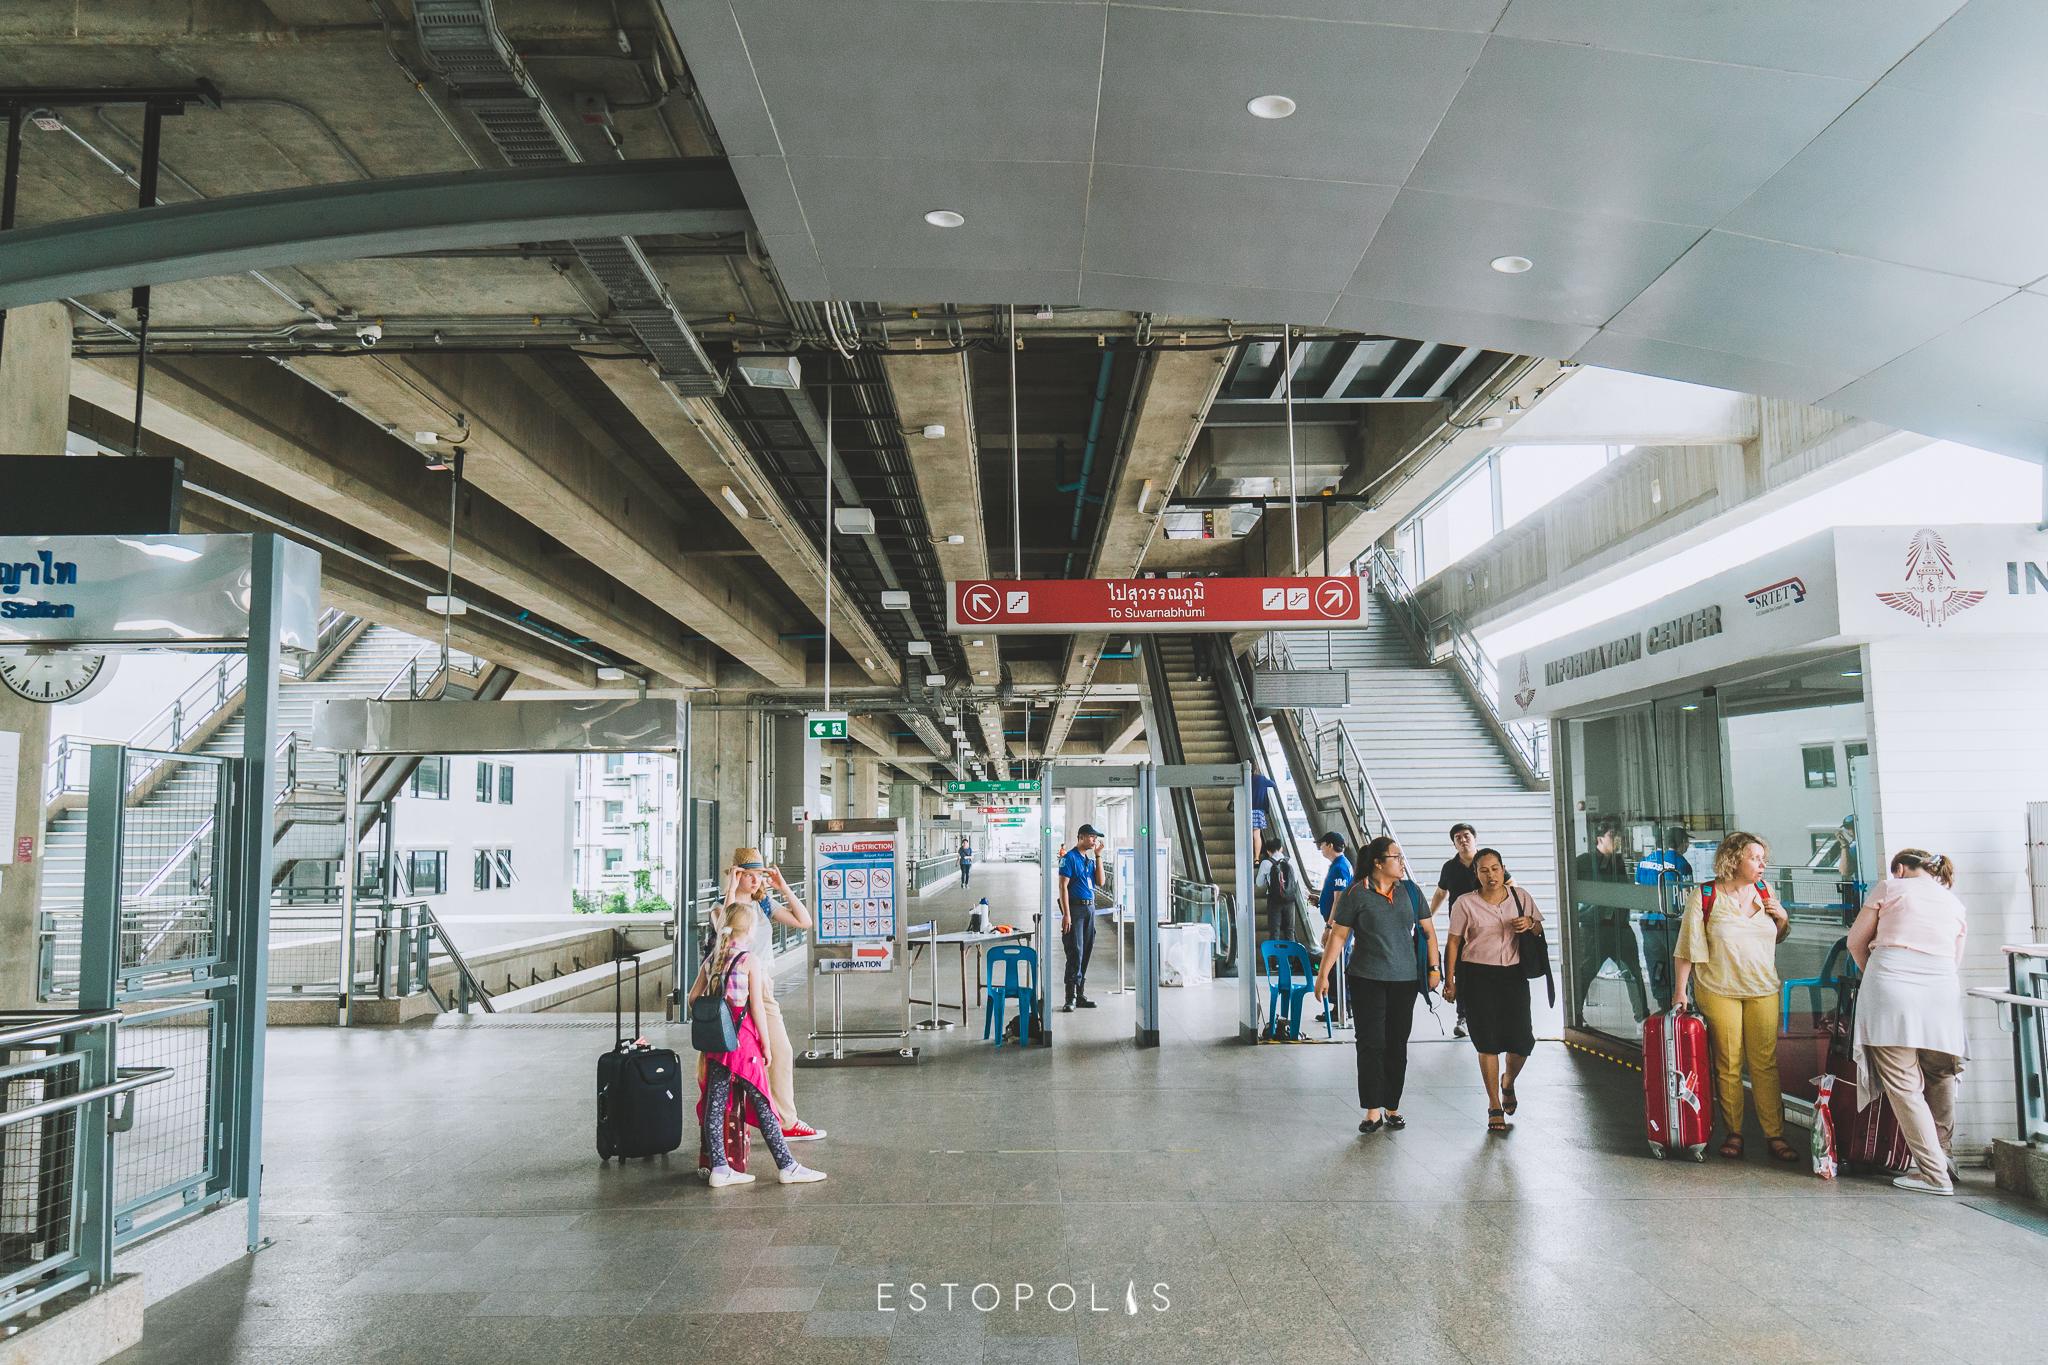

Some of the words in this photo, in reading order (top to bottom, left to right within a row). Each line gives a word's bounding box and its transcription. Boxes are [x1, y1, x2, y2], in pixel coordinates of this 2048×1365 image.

[1107, 581, 1204, 607] ไปสุวรรณภูมิ
[1755, 586, 1789, 609] SRTET
[1108, 607, 1121, 618] To
[1125, 606, 1205, 618] Suvarnabhumi
[1545, 632, 1641, 686] INFORMATION
[1646, 604, 1723, 655] CENTER
[819, 842, 850, 852] ข้อห้าม
[853, 843, 893, 851] RESTRICTION
[830, 960, 882, 969] INFORMATION
